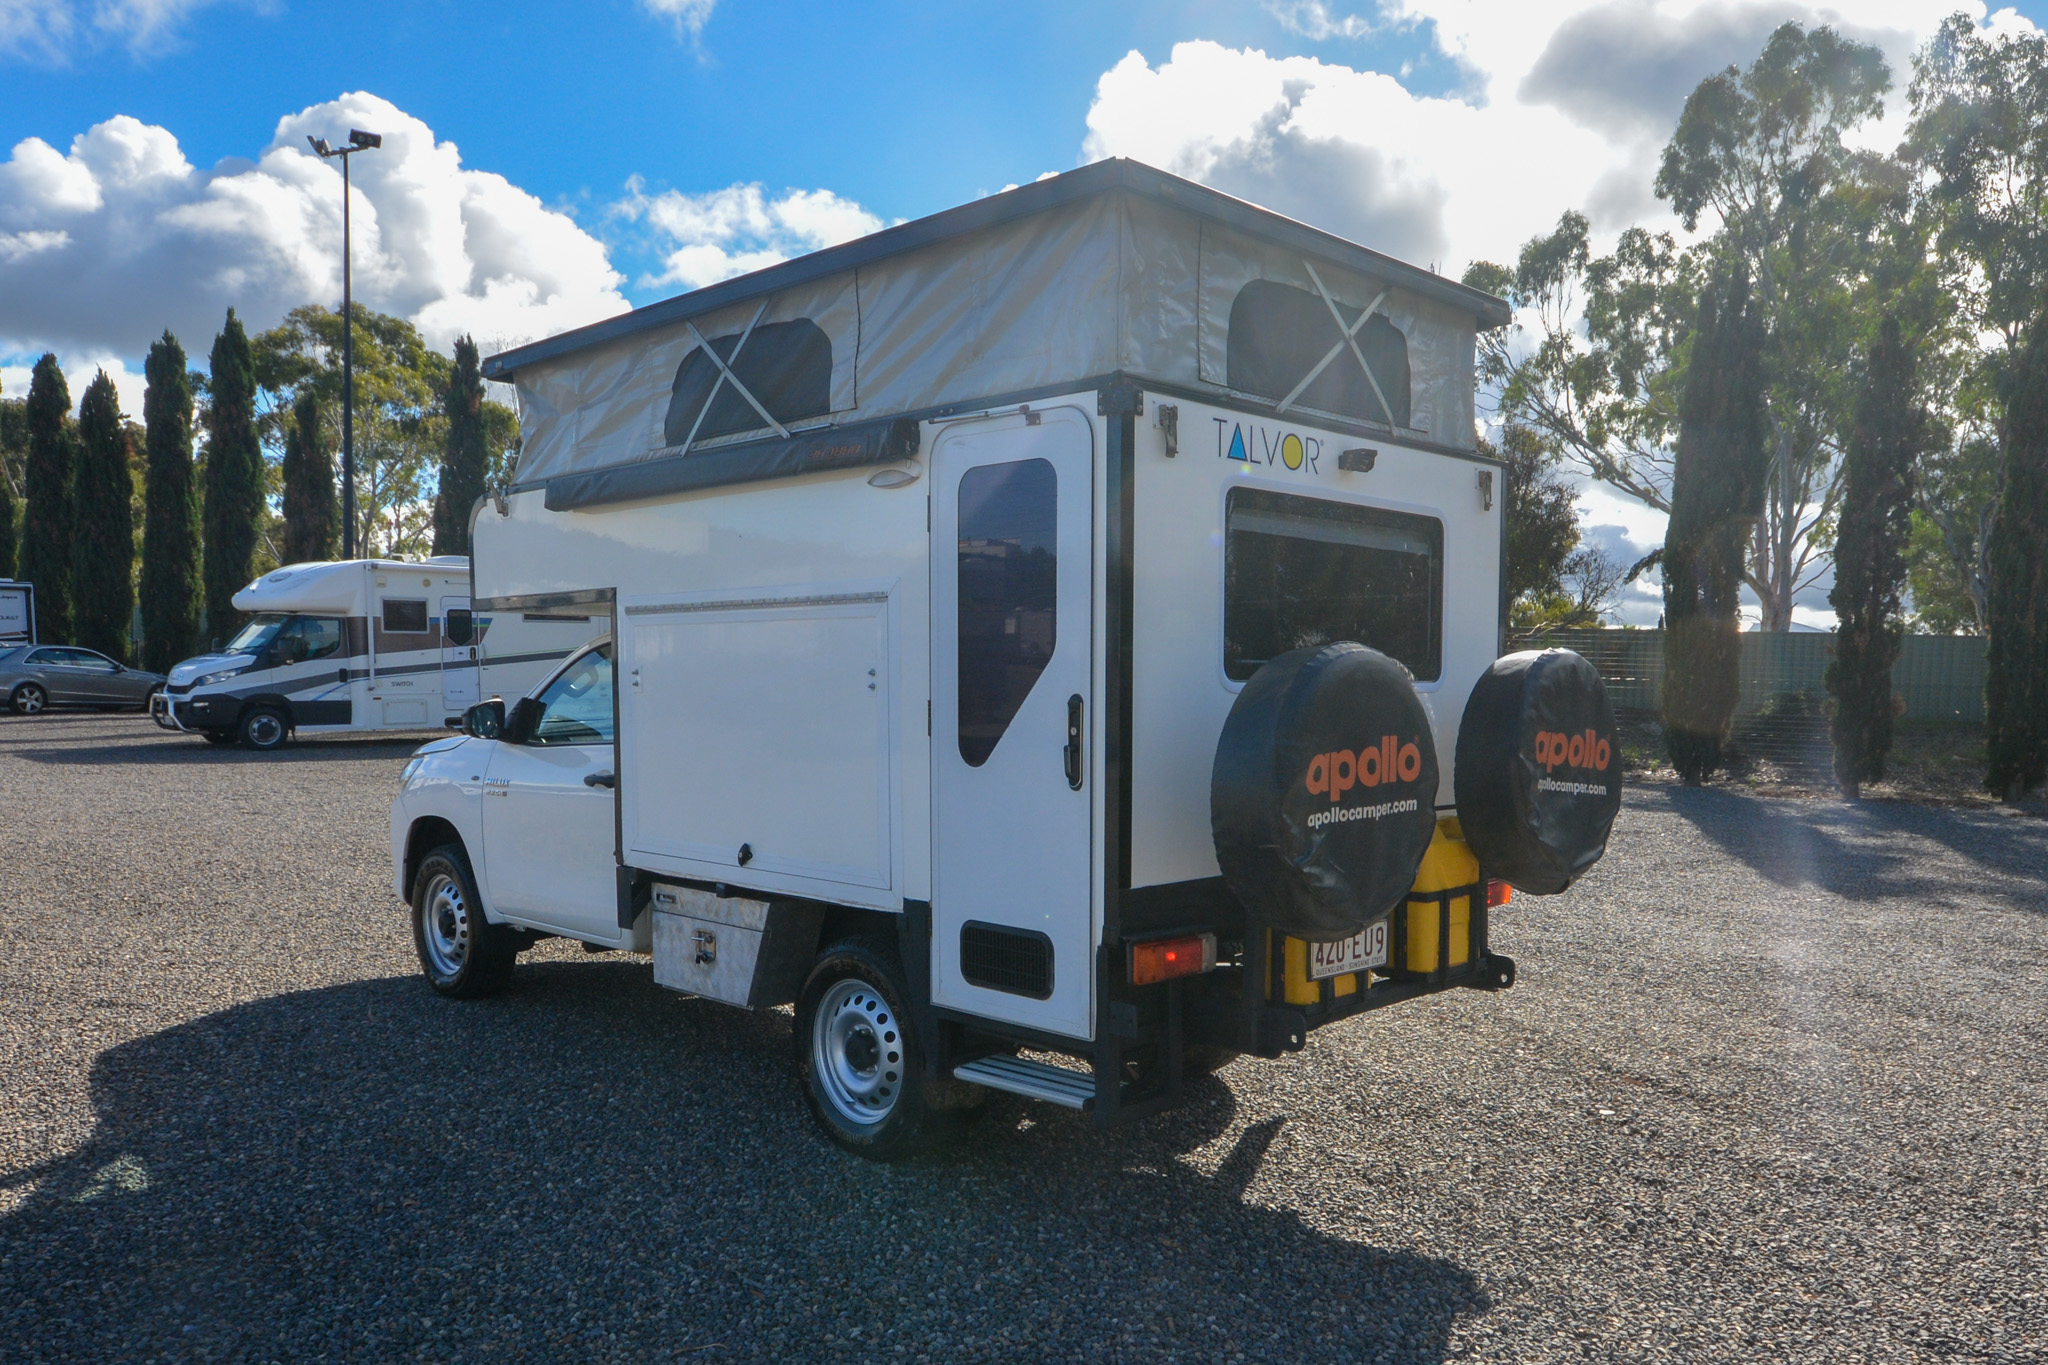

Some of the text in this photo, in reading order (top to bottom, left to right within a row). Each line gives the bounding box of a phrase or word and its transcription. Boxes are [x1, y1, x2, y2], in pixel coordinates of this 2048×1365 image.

[1213, 417, 1319, 475] TALVOR
[1305, 735, 1421, 802] apollo
[1535, 729, 1611, 773] apollo
[1307, 798, 1418, 829] apollocamper.com
